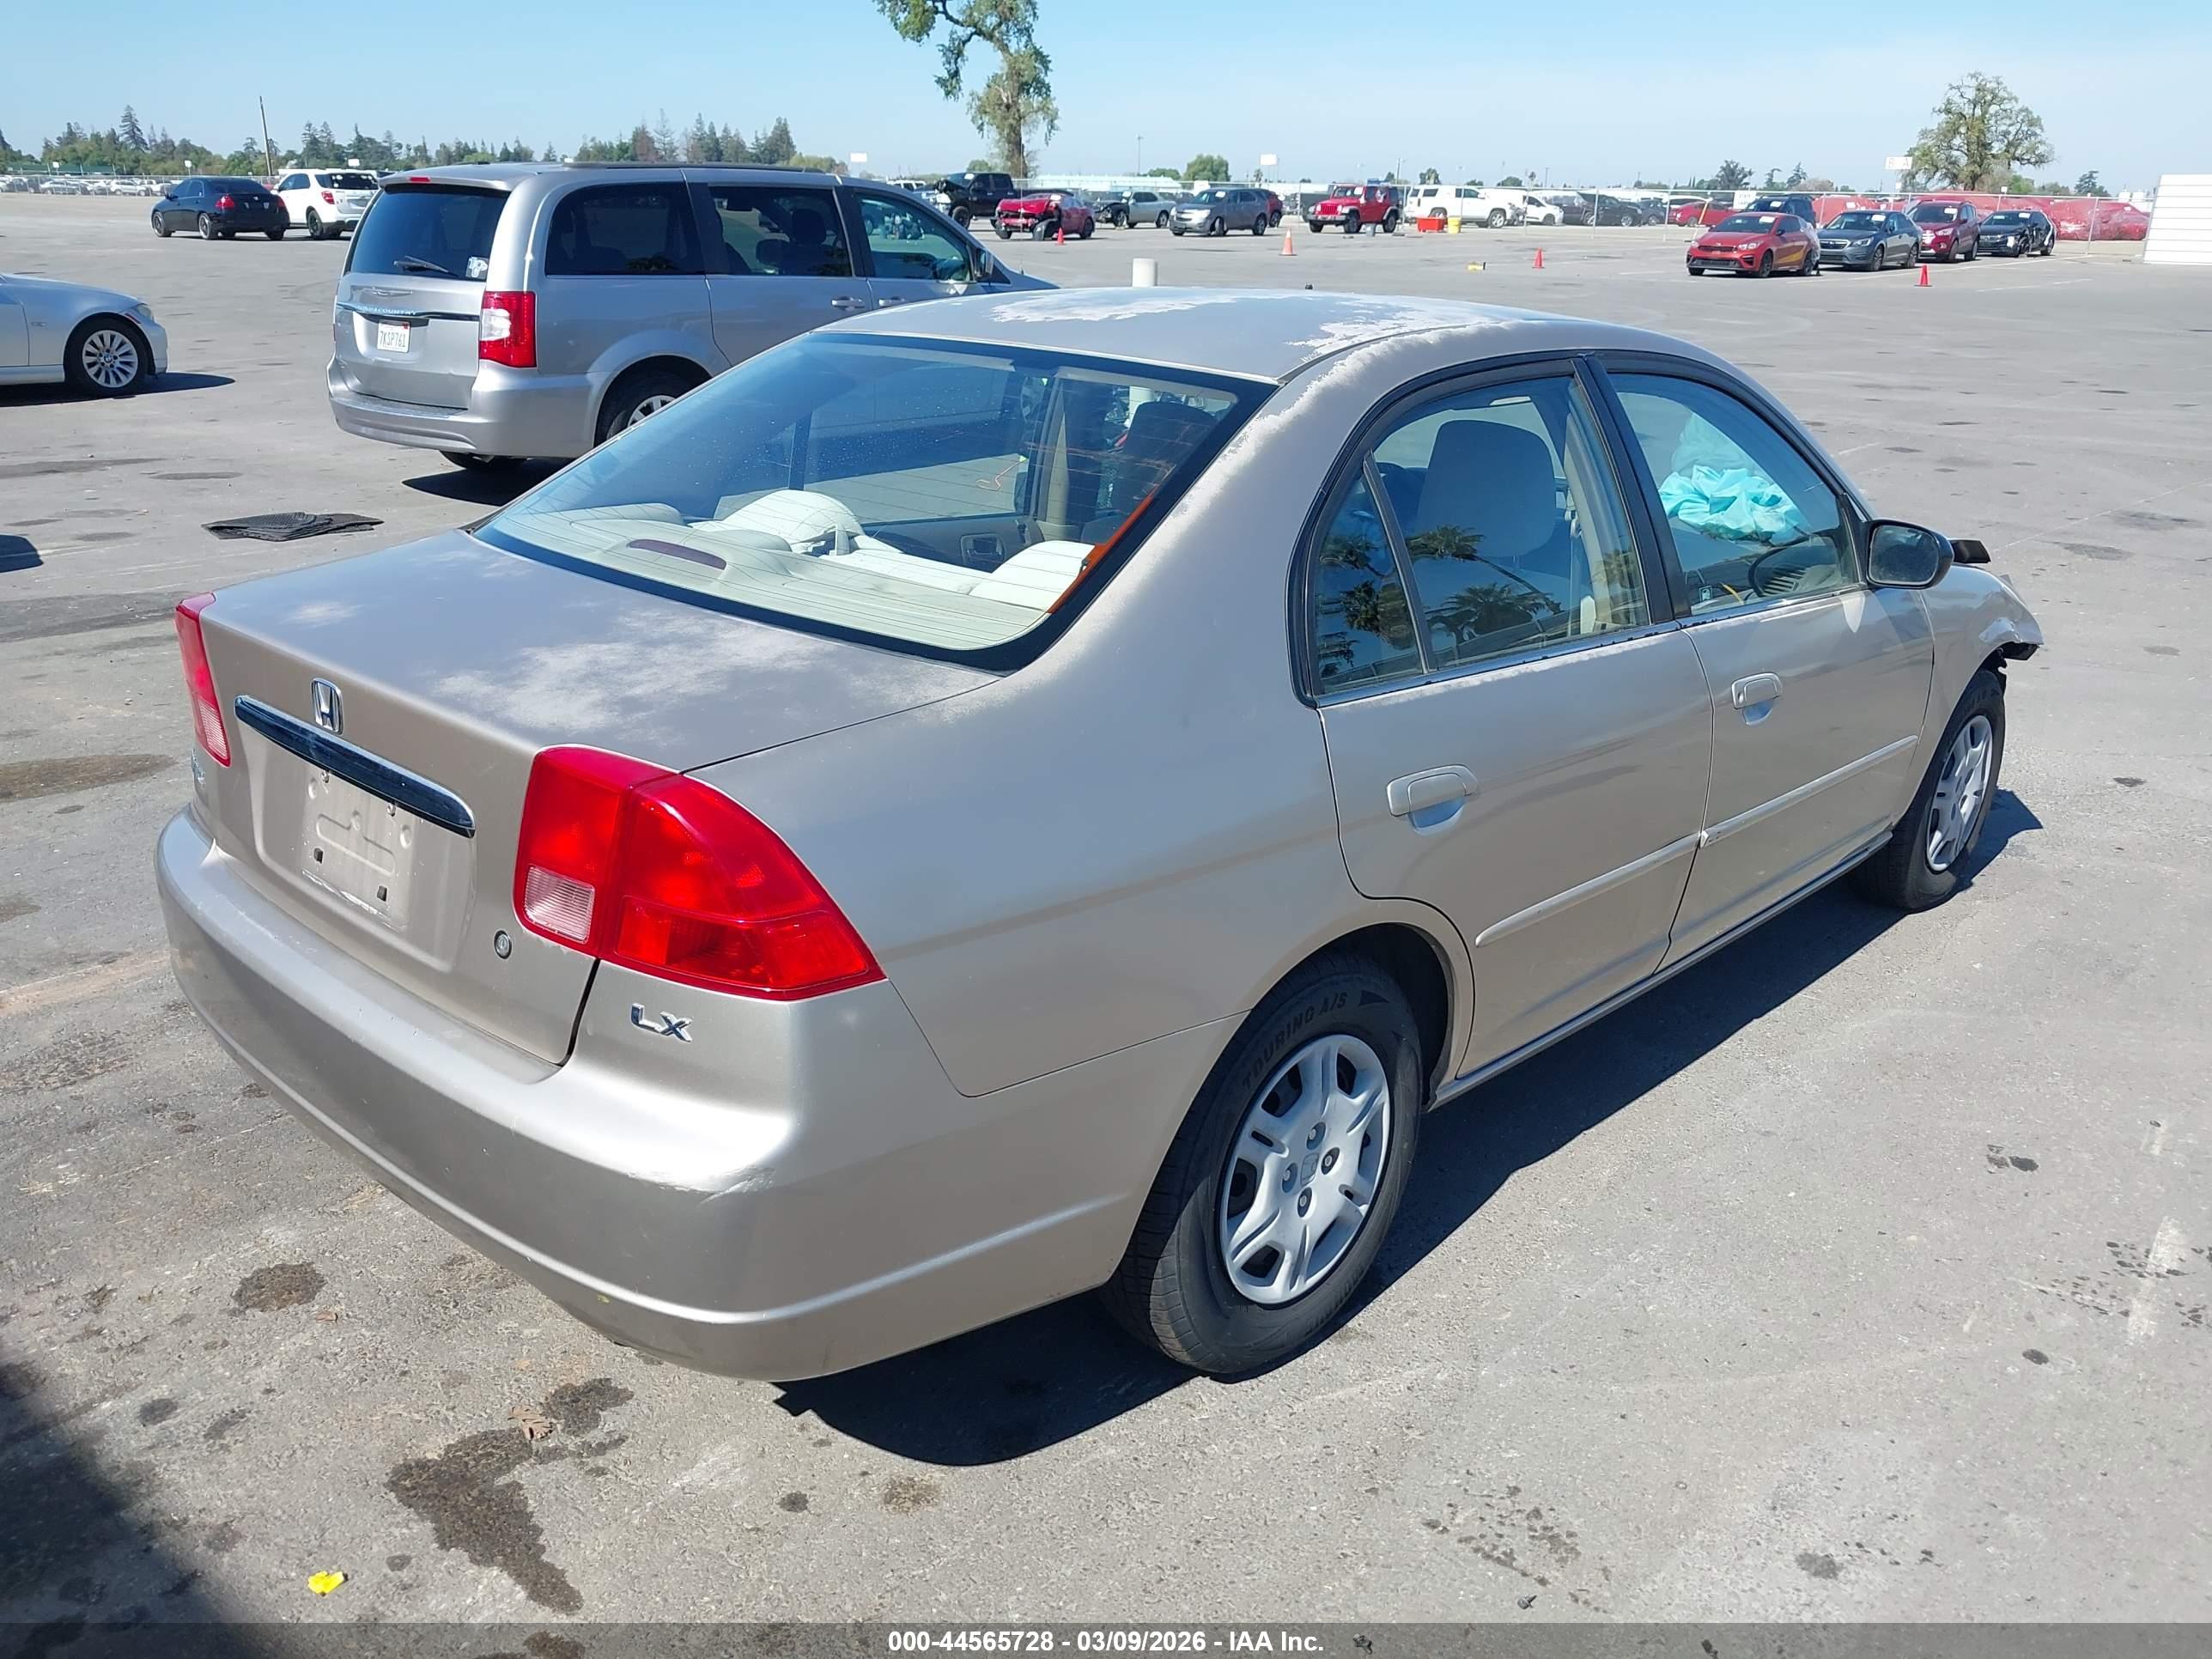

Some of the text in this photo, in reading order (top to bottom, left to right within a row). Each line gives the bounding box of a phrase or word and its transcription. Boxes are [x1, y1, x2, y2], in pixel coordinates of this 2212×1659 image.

[630, 1002, 694, 1042] LX
[1242, 992, 1348, 1090] TOURING A/S
